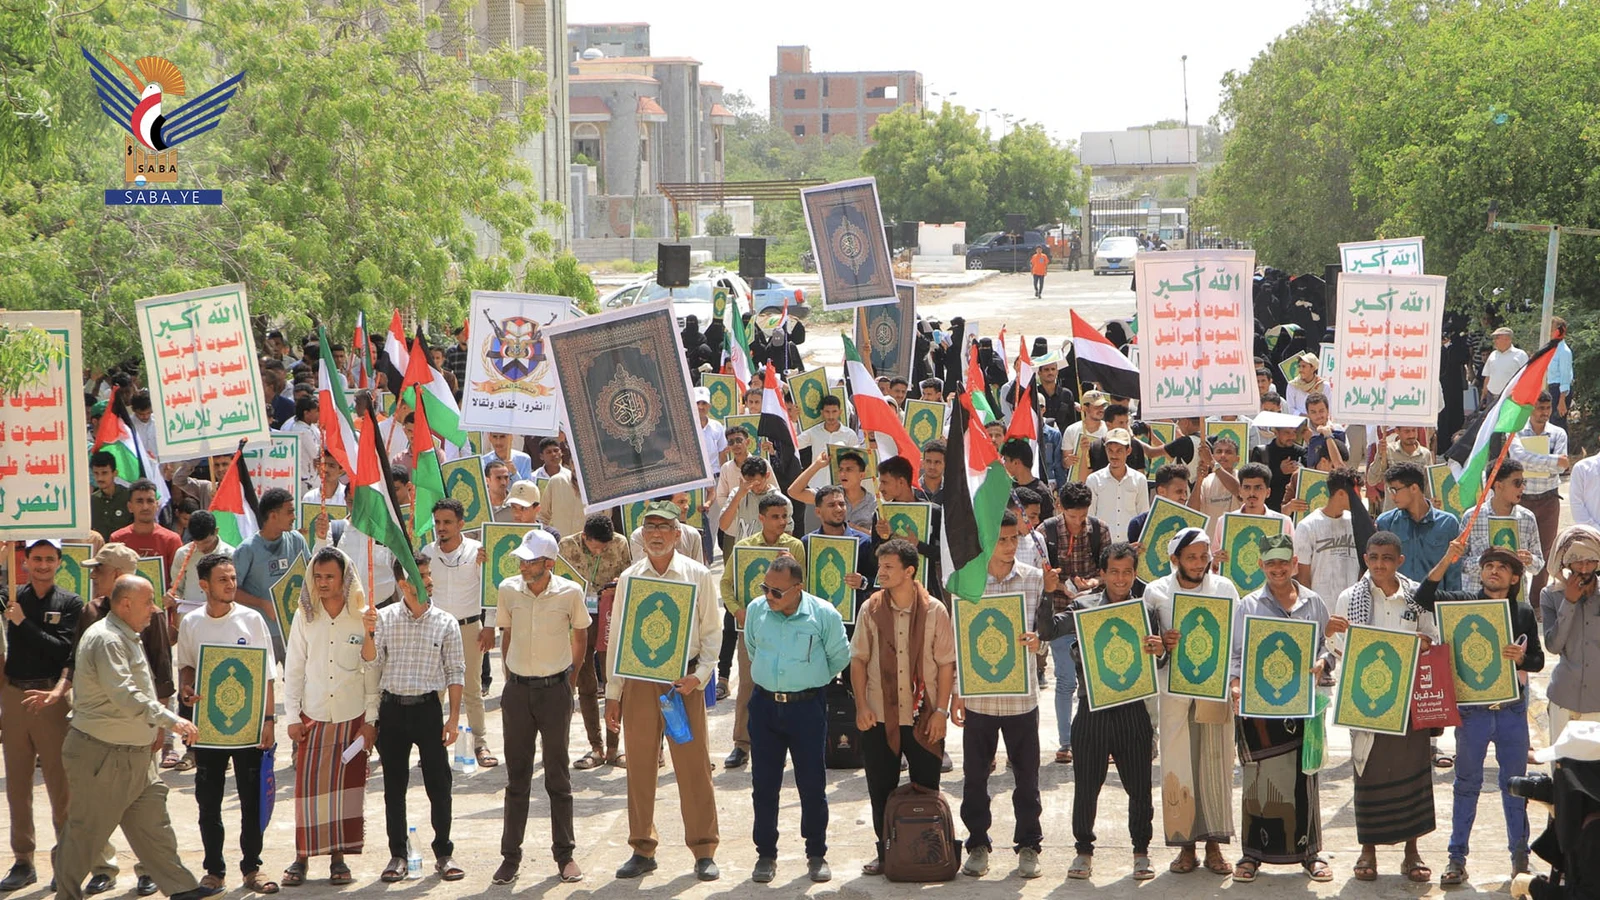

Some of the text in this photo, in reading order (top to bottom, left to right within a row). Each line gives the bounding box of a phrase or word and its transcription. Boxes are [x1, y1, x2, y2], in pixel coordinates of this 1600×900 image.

[1350, 248, 1416, 273] الله أكبر
[1152, 265, 1239, 299] الله أكبر
[1204, 303, 1239, 319] الموت
[1348, 288, 1430, 316] الله أكبر
[155, 302, 239, 340] الله أكبر
[1394, 322, 1428, 337] الموت
[206, 331, 243, 353] الموت
[1205, 328, 1240, 344] الموت
[1155, 351, 1243, 369] اللعنة على اليهود
[1392, 345, 1427, 358] الموت
[210, 355, 247, 375] الموت
[1346, 365, 1426, 381] اللعنة على اليهود
[9, 387, 63, 412] الموت
[165, 380, 251, 408] اللعنة على اليهود
[1156, 373, 1246, 403] النصر للإسلام
[1345, 387, 1425, 411] النصر للإسلام
[168, 401, 255, 438] النصر للإسلام
[11, 421, 64, 446] الموت
[269, 441, 294, 458] الله
[25, 454, 65, 475] اللعنة
[265, 466, 293, 479] الموت
[12, 482, 66, 520] النصر
